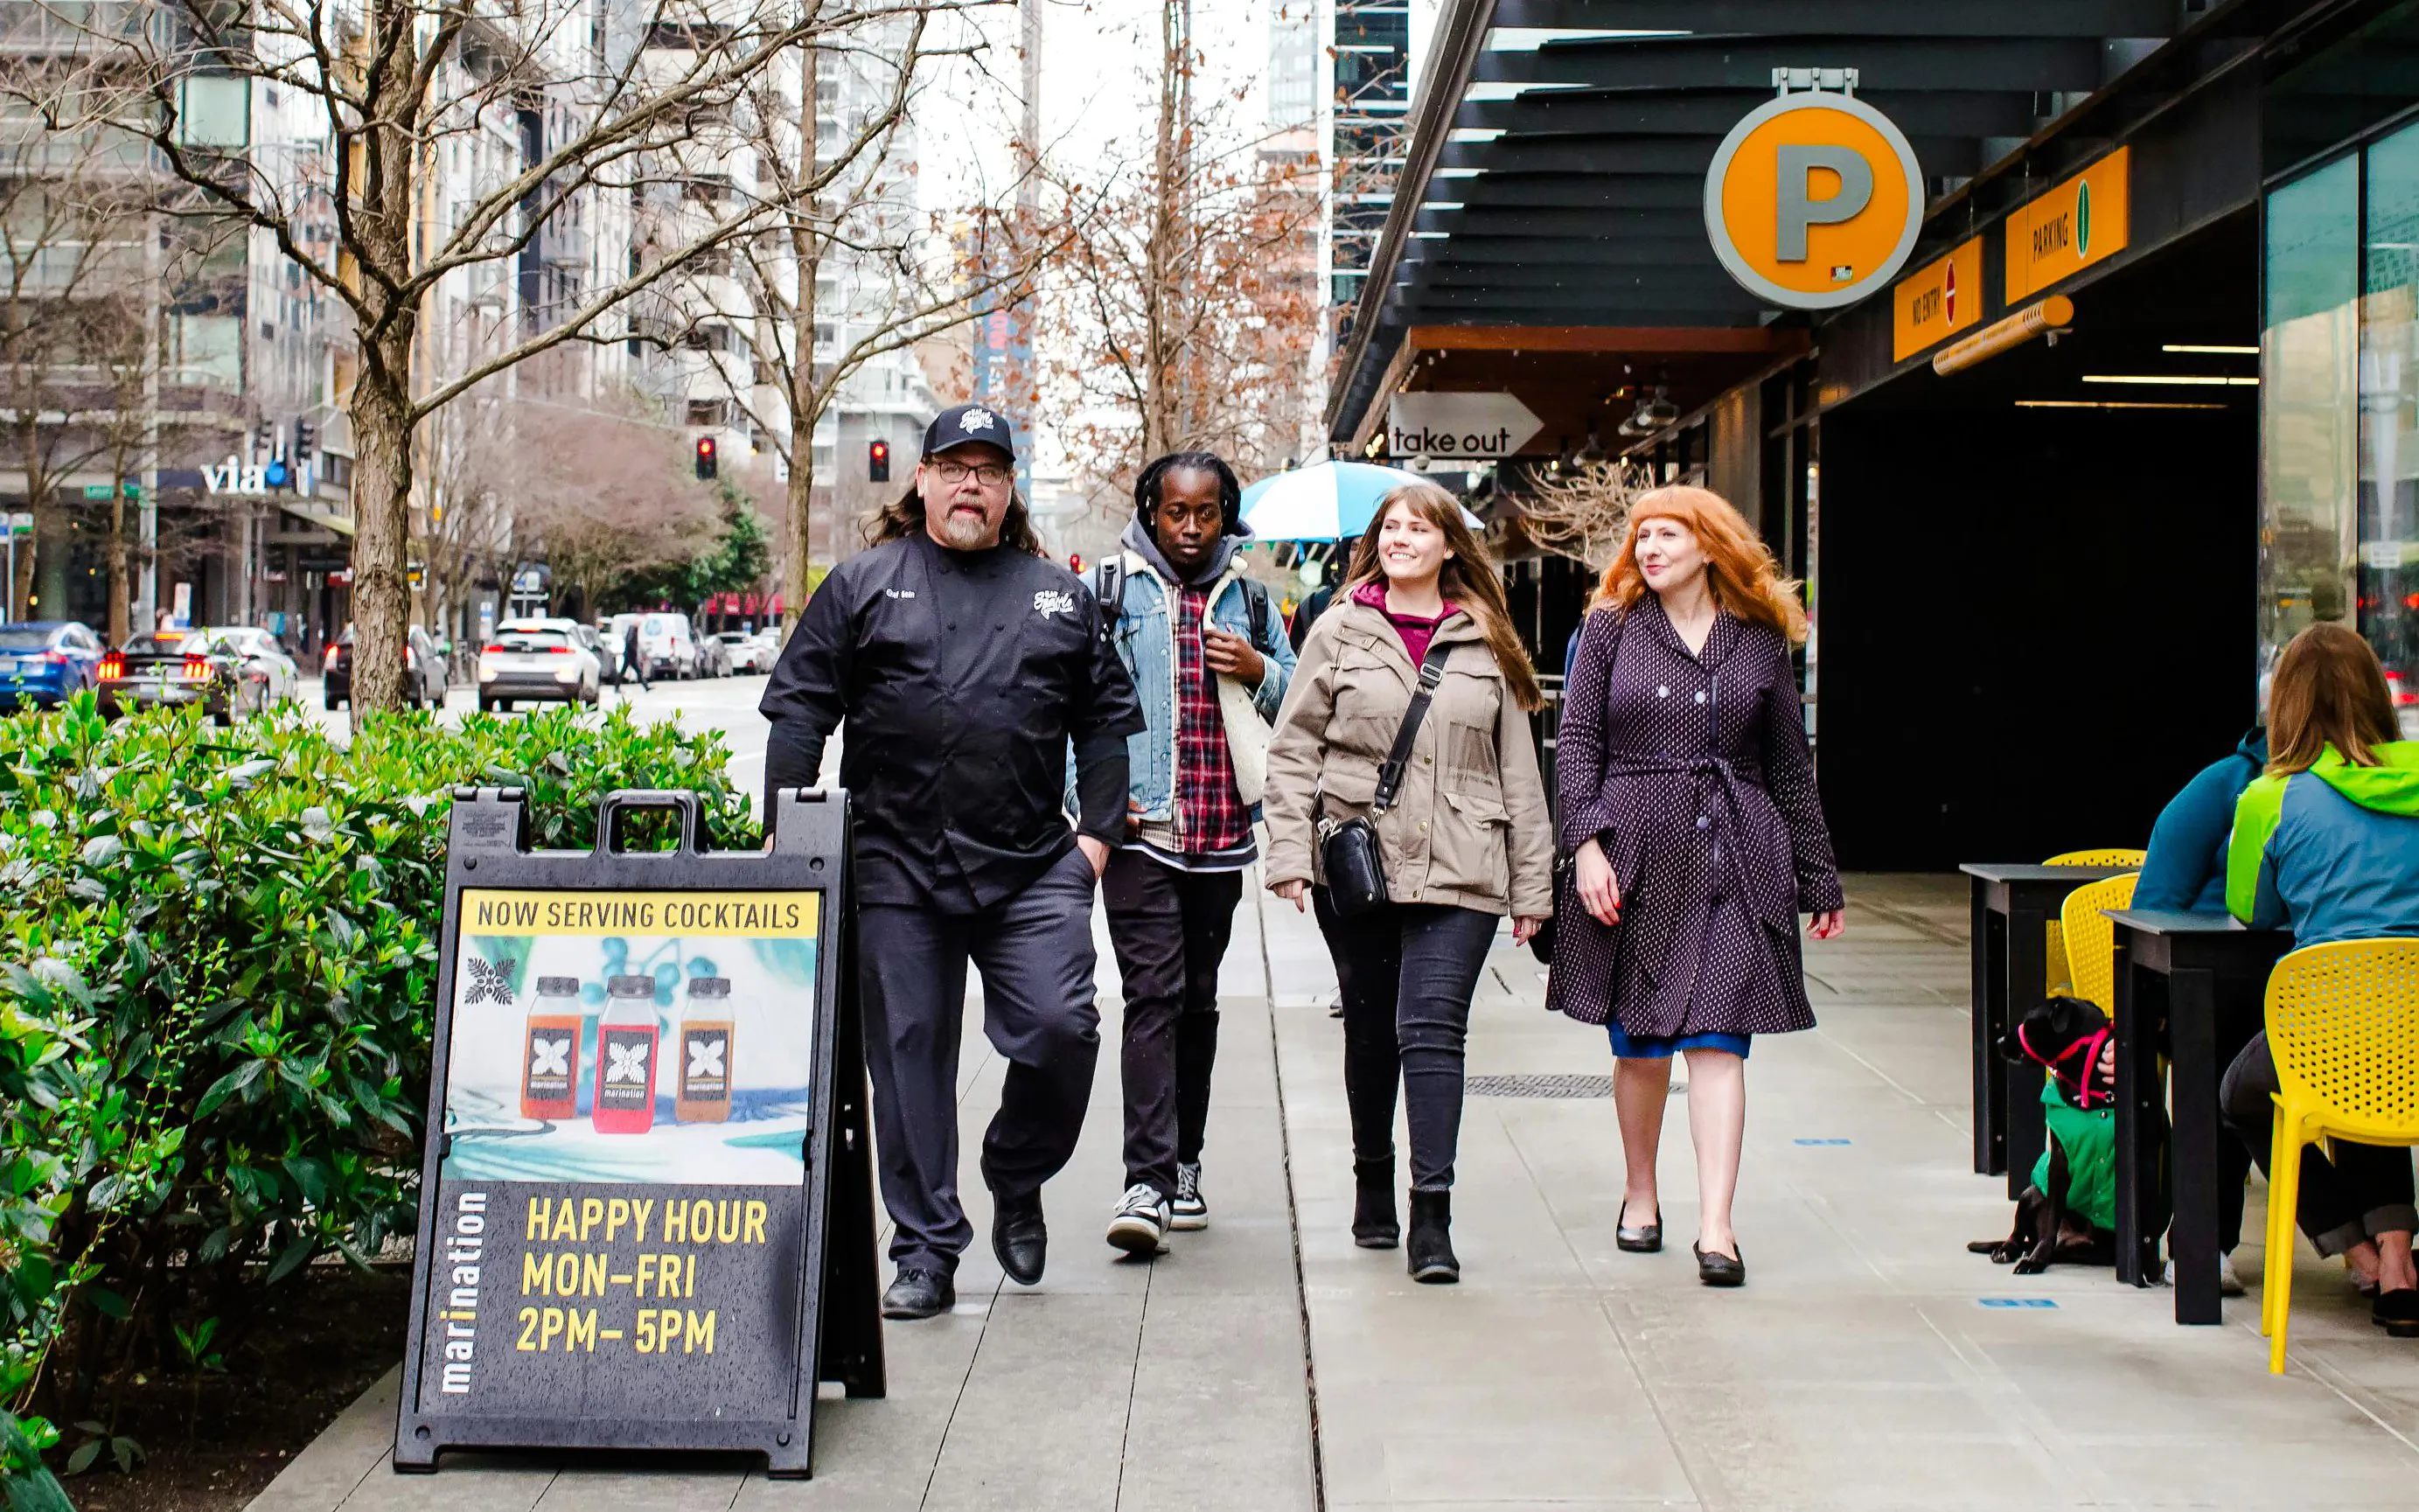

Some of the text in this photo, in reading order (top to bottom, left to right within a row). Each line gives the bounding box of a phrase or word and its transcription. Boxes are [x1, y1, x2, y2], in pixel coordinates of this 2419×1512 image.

[1777, 145, 1874, 263] P
[2033, 211, 2068, 263] PARKING
[1913, 286, 1941, 326] NO ENTRY
[1394, 427, 1511, 453] take out
[478, 901, 800, 930] NOW SERVING COCKTAILS
[603, 1089, 645, 1098] marination
[526, 1196, 768, 1244] HAPPY HOUR
[439, 1191, 487, 1394] marination
[634, 1309, 716, 1355] 5PM
